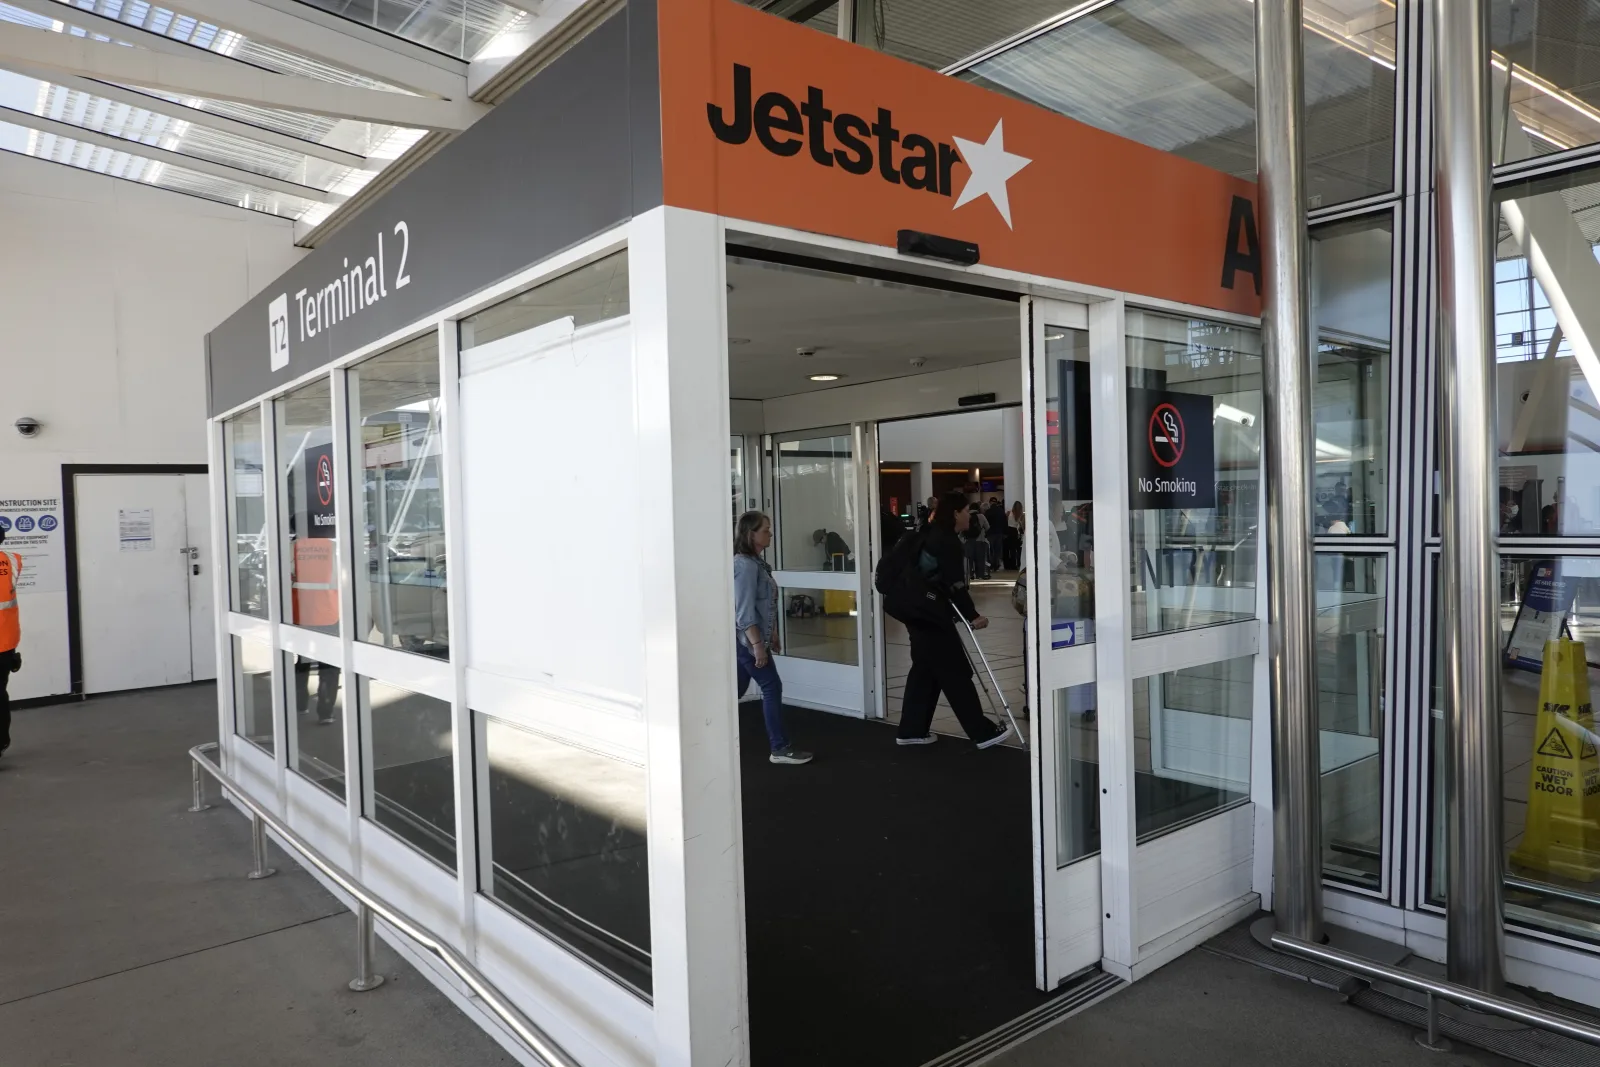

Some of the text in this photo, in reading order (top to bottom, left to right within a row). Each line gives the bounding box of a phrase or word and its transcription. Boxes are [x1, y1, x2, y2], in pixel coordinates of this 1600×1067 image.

[707, 62, 963, 197] Jetstar
[295, 220, 411, 342] Terminal 2
[272, 315, 287, 354] T2
[1138, 477, 1197, 497] No Smoking
[43, 498, 58, 506] SITE
[1536, 765, 1574, 778] CAUTION
[1541, 773, 1568, 786] WET
[1534, 781, 1574, 797] FLOOR
